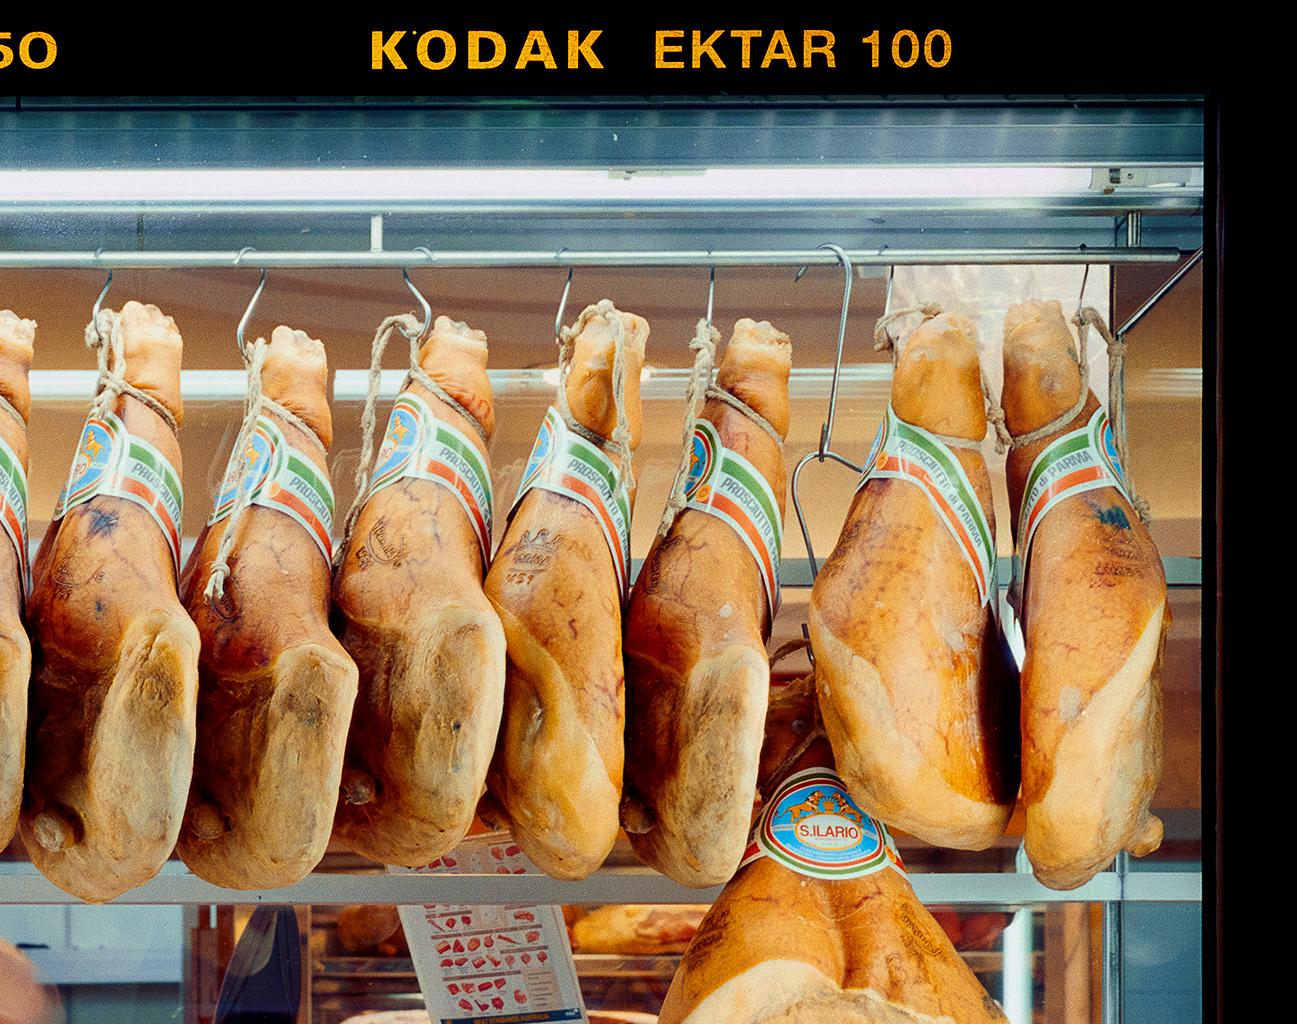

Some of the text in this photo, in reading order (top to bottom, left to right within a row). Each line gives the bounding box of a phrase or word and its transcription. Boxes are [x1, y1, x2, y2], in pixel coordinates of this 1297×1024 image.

[1048, 449, 1094, 478] PARMA
[568, 458, 620, 516] PROSCIUTTO
[721, 476, 771, 536] PROSCIUTTO
[955, 505, 982, 549] PARMA
[799, 824, 859, 839] S.ILARIO
